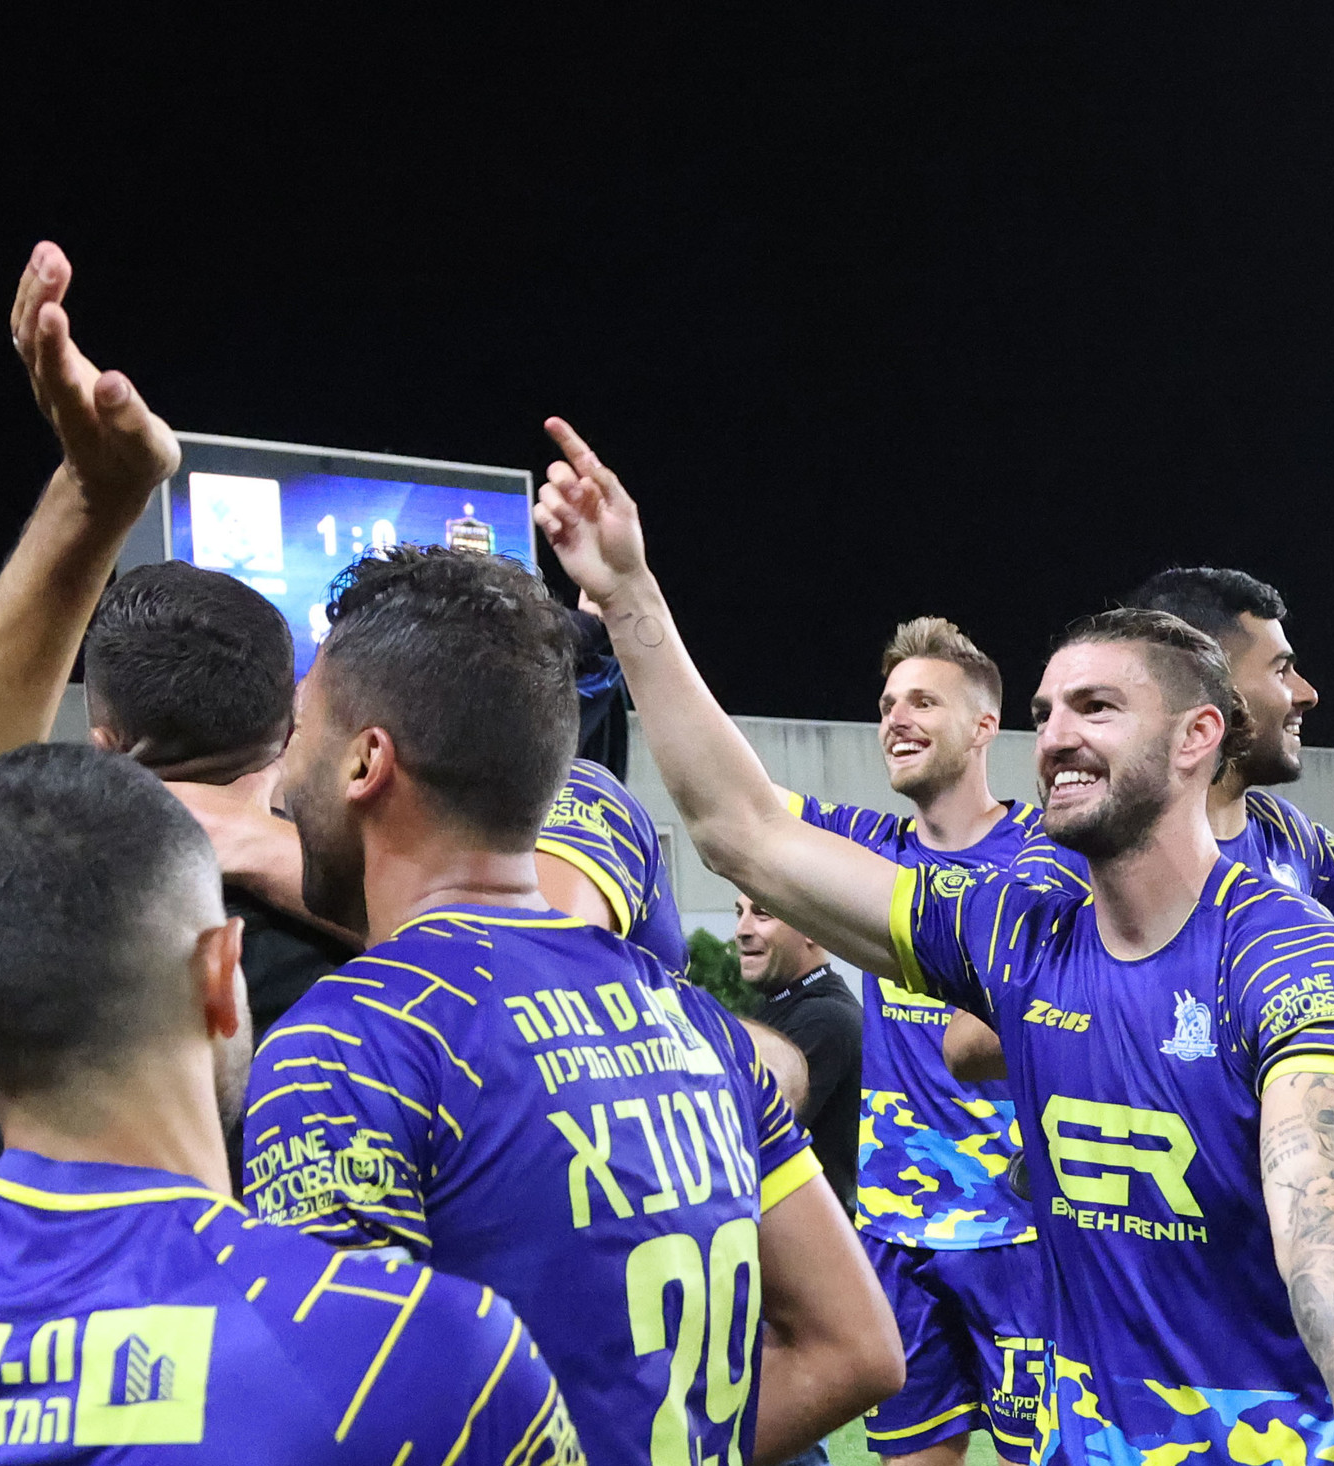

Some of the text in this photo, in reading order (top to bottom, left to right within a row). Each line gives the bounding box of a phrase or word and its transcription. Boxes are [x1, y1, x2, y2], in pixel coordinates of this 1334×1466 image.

[1022, 998, 1092, 1033] Zeus
[1260, 973, 1334, 1018] TOPLINE
[534, 1045, 621, 1095] התיכון
[245, 1127, 331, 1185] TOPLINE
